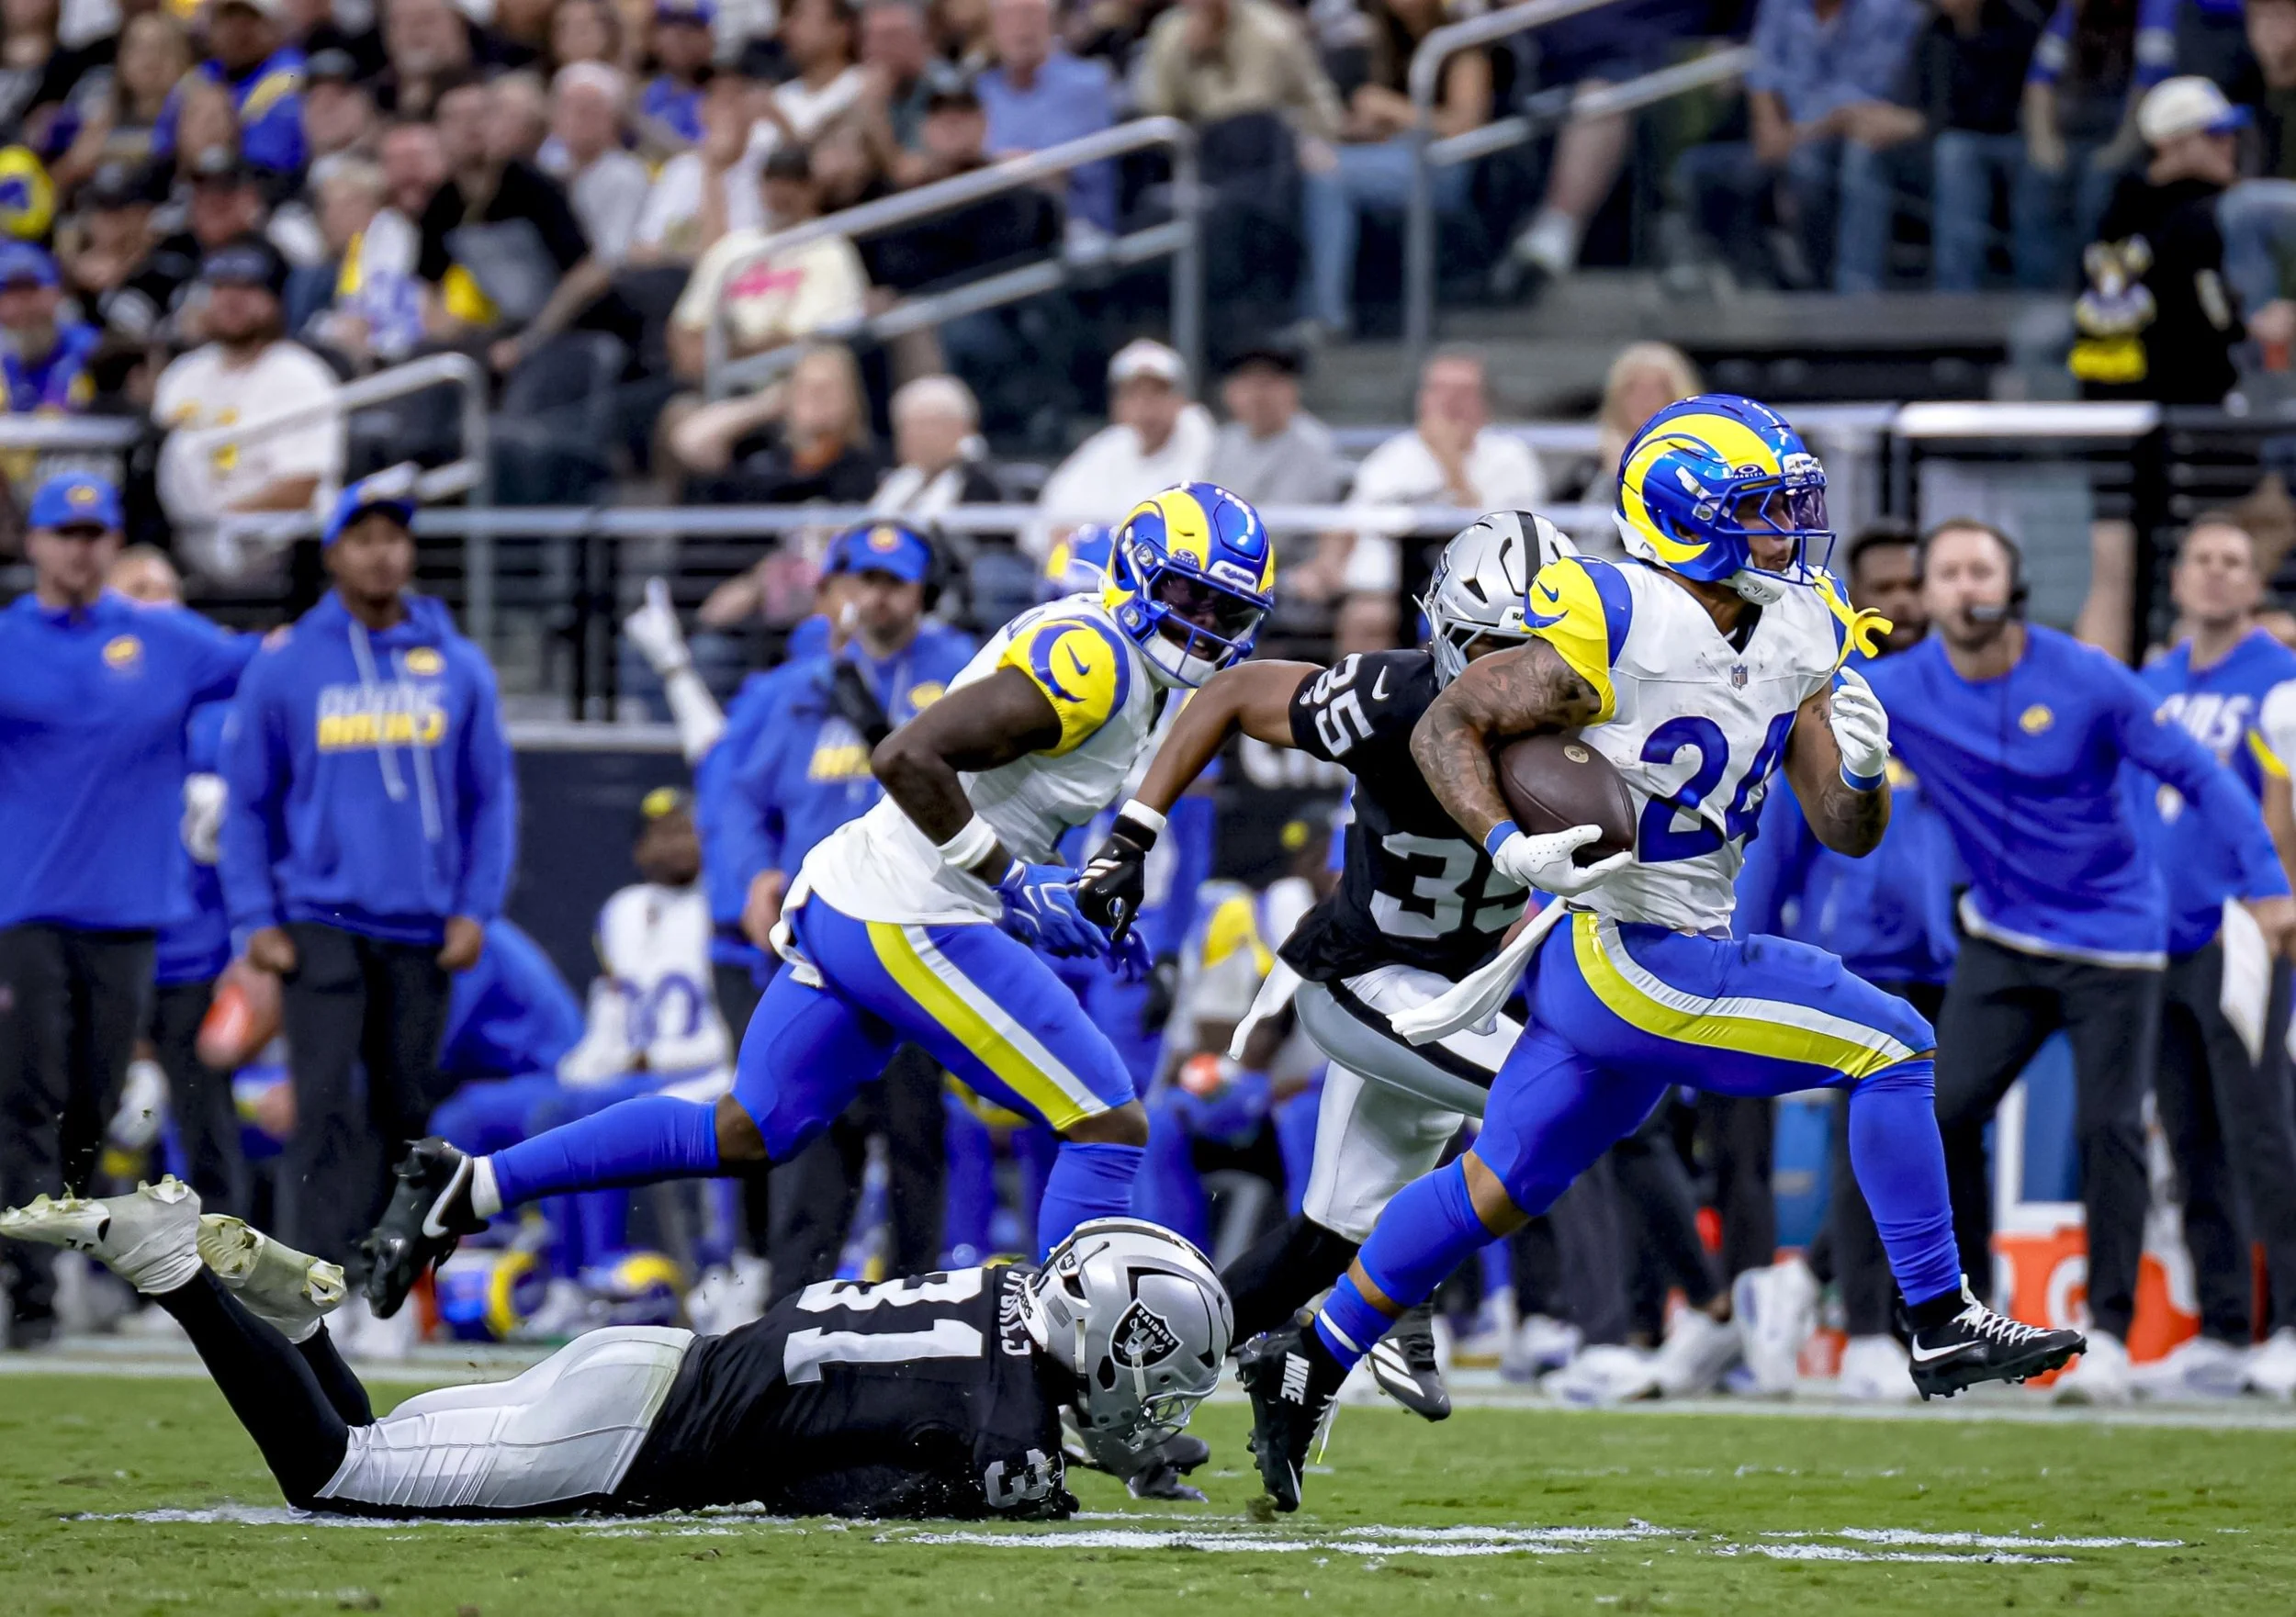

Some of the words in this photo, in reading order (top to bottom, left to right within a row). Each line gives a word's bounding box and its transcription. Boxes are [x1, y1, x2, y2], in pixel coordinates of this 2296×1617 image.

[1313, 653, 1374, 758] 35
[1638, 710, 1797, 863] 24
[783, 1266, 983, 1386] 31
[1136, 1308, 1176, 1346] RAIDERS
[1280, 1352, 1310, 1406] NIKE
